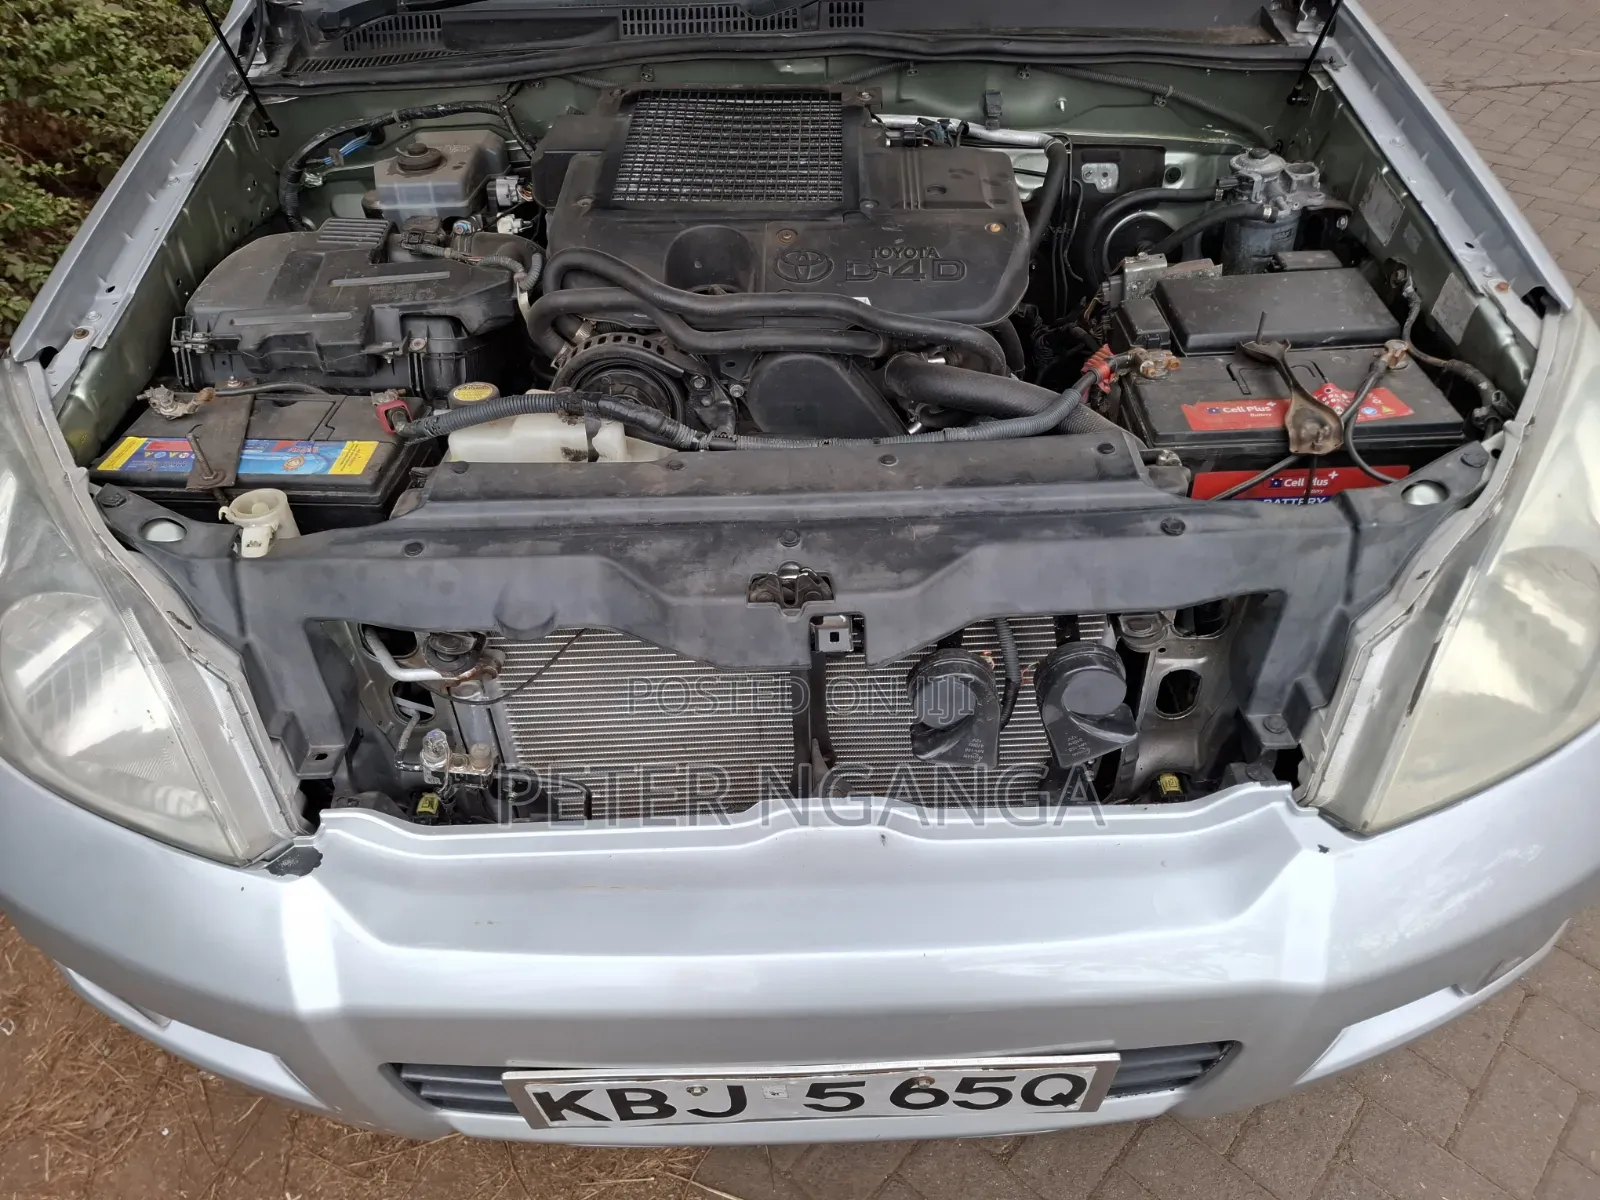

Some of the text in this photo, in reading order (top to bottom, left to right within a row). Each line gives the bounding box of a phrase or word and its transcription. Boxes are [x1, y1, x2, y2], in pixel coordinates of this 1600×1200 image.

[871, 246, 941, 259] TOYOTA
[845, 259, 967, 282] D-4D
[1283, 477, 1329, 487] Cell lus
[532, 1085, 748, 1121] KBJ
